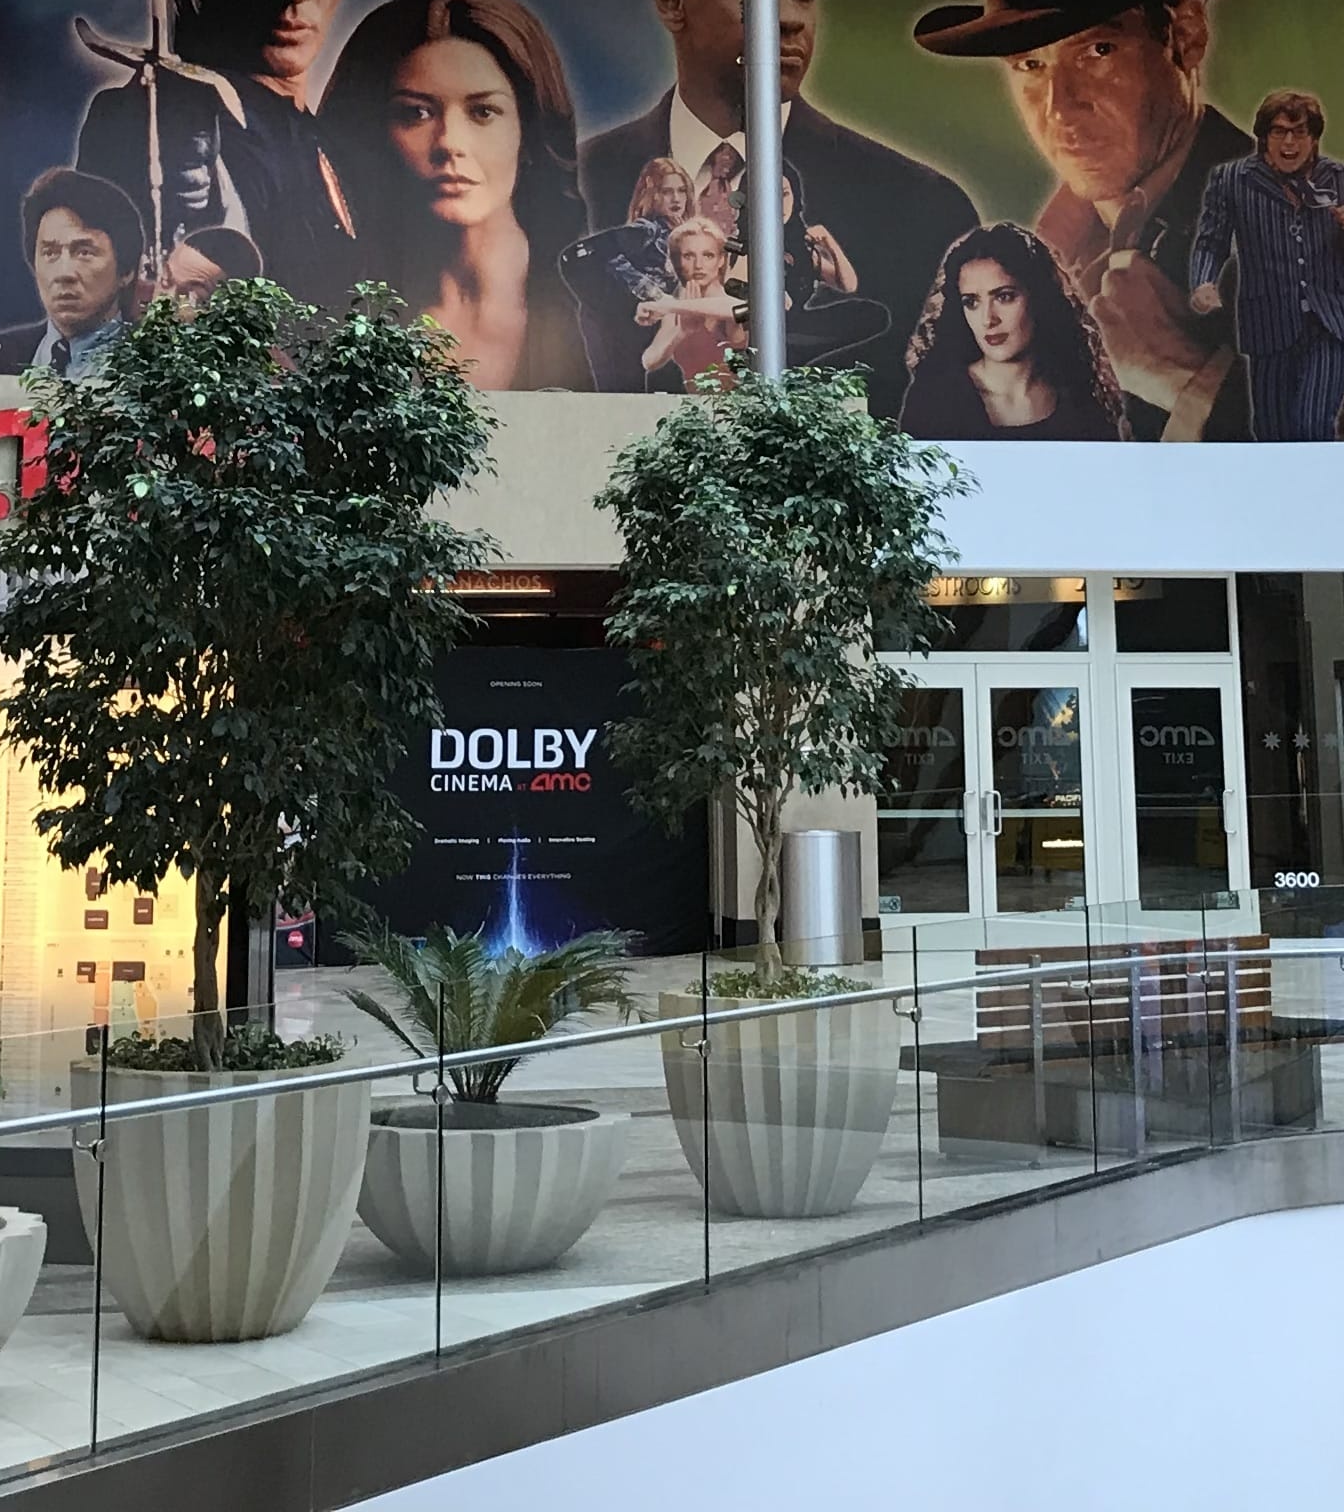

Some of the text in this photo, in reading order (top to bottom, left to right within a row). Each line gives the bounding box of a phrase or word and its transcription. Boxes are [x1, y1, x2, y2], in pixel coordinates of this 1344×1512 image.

[458, 574, 543, 591] NACHOS
[431, 728, 598, 770] DOLBY
[430, 774, 514, 793] CINEMA
[1274, 871, 1320, 888] 3600
